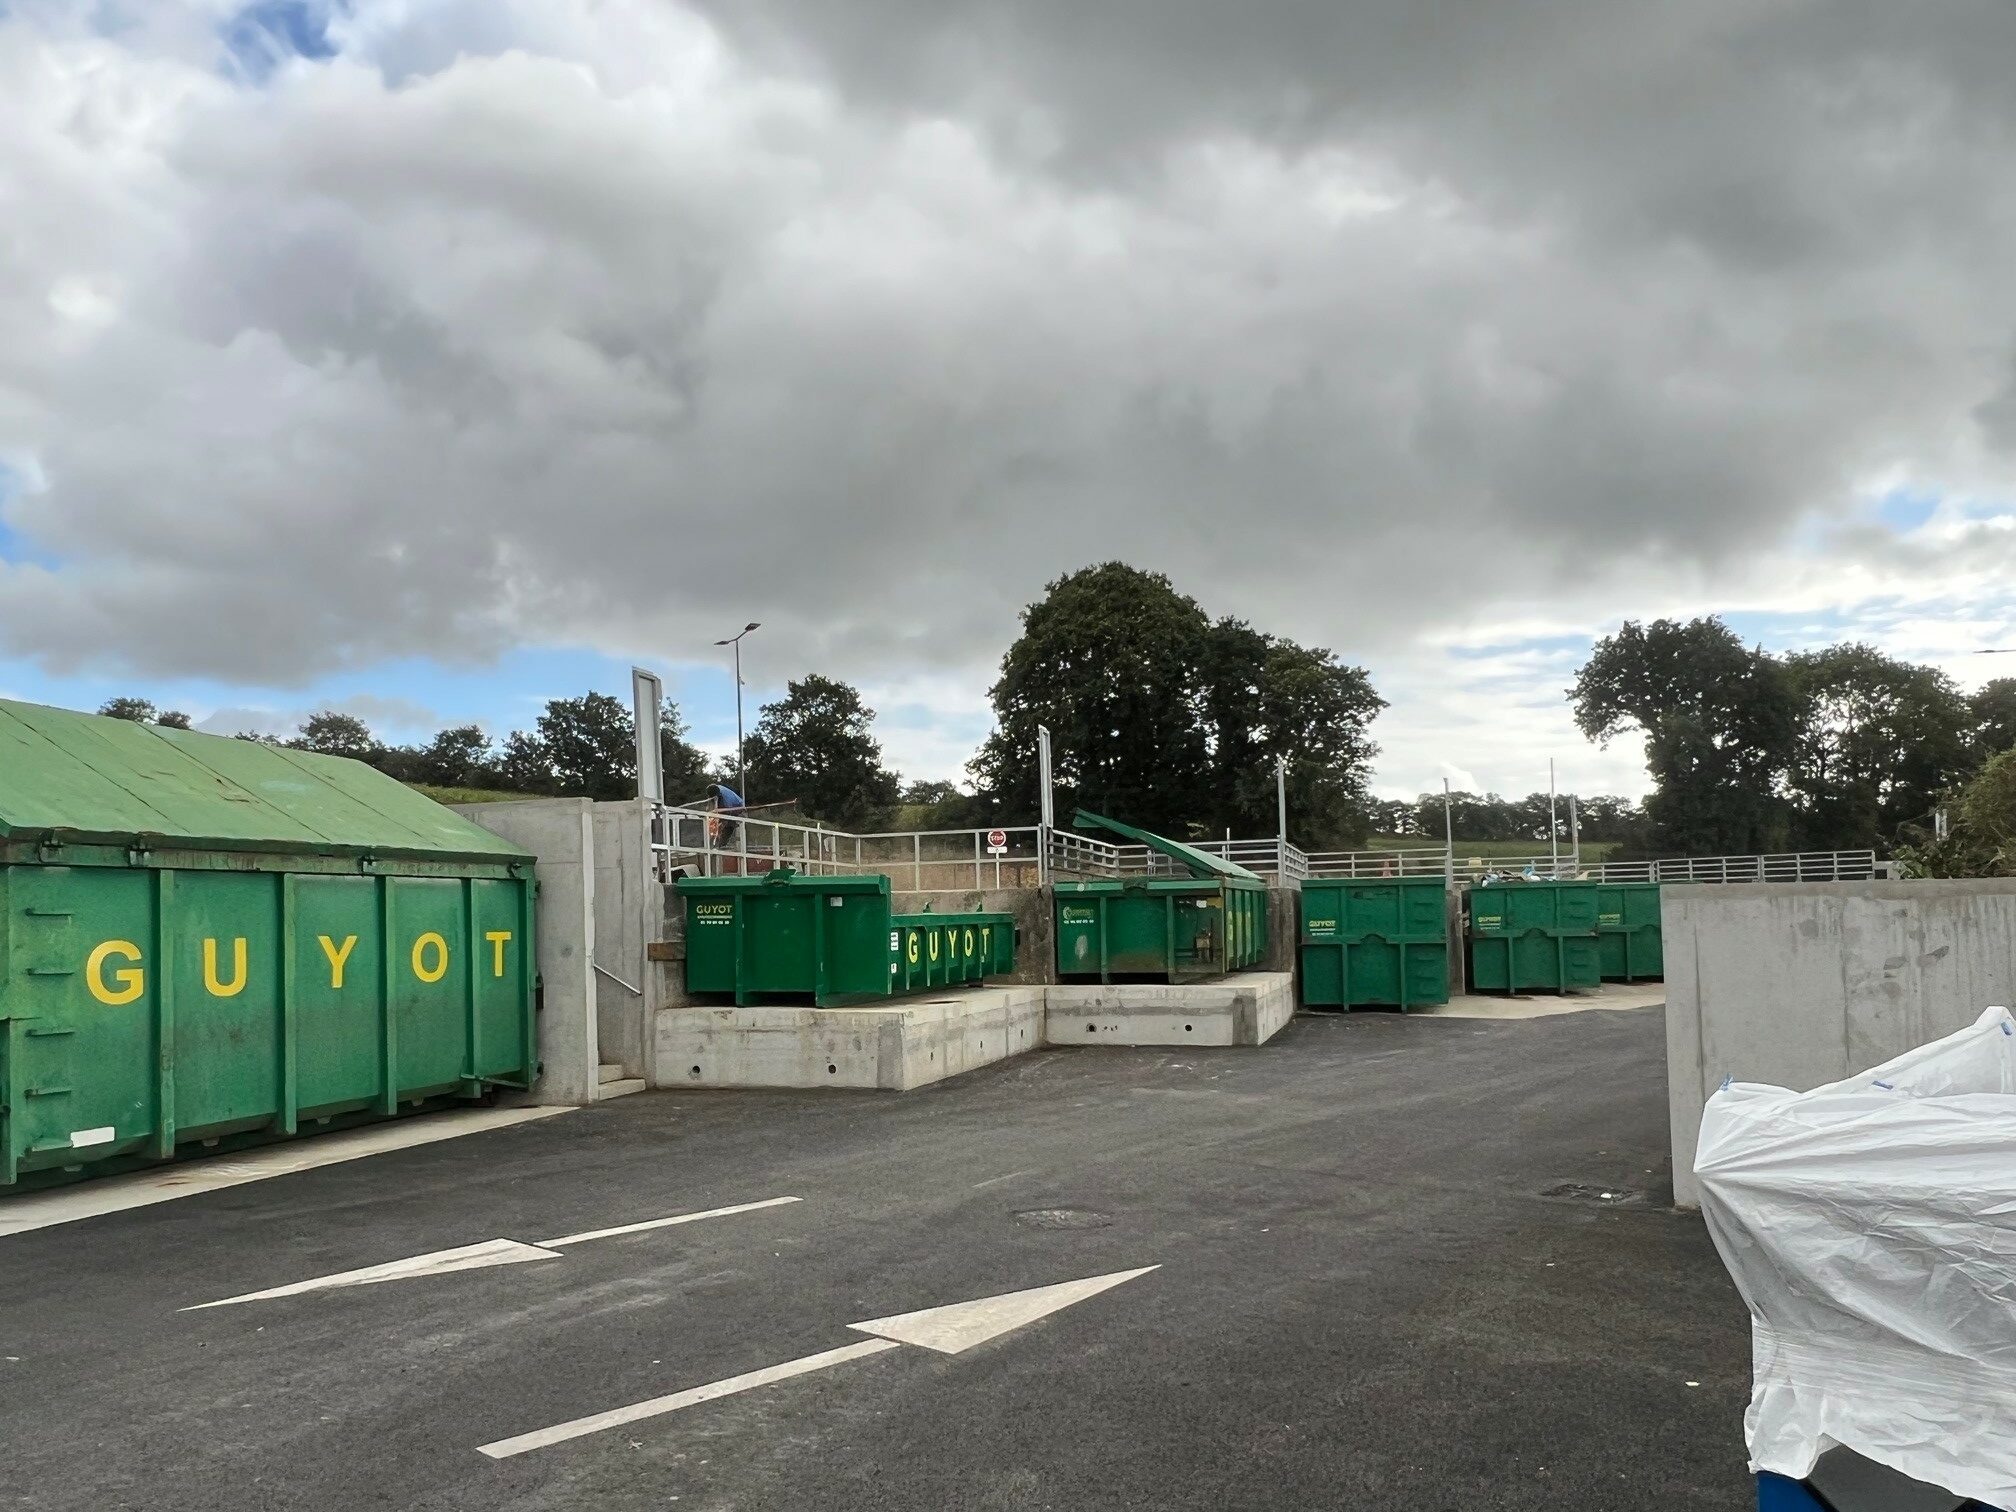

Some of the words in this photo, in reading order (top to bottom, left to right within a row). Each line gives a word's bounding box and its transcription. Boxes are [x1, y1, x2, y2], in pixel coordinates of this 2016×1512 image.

[696, 904, 732, 914] GUYOT
[908, 928, 990, 963] GUYOT
[86, 931, 512, 1005] GUYOT
